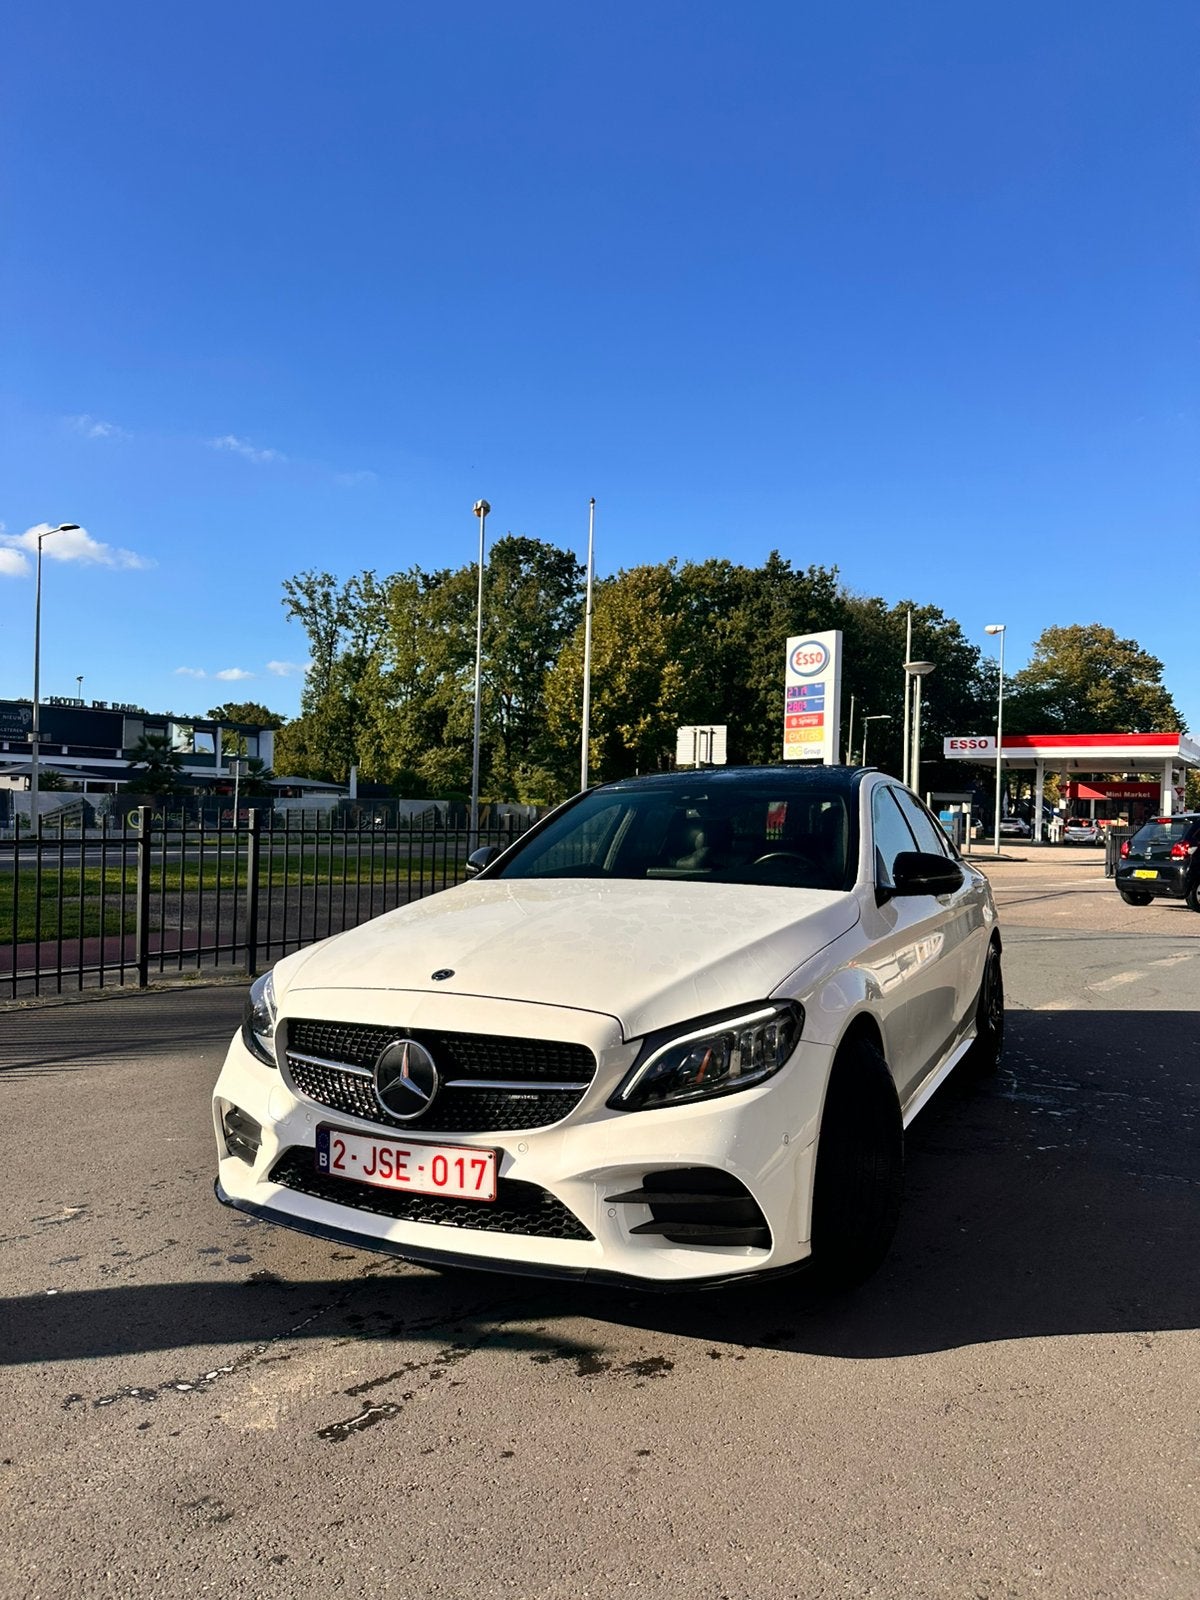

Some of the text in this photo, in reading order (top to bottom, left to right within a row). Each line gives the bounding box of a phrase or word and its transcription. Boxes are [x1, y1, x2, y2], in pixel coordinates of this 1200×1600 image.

[49, 696, 88, 709] HOTEL
[92, 700, 108, 710] DE
[789, 730, 822, 742] extras
[950, 739, 988, 750] ESSO
[319, 1152, 328, 1167] B
